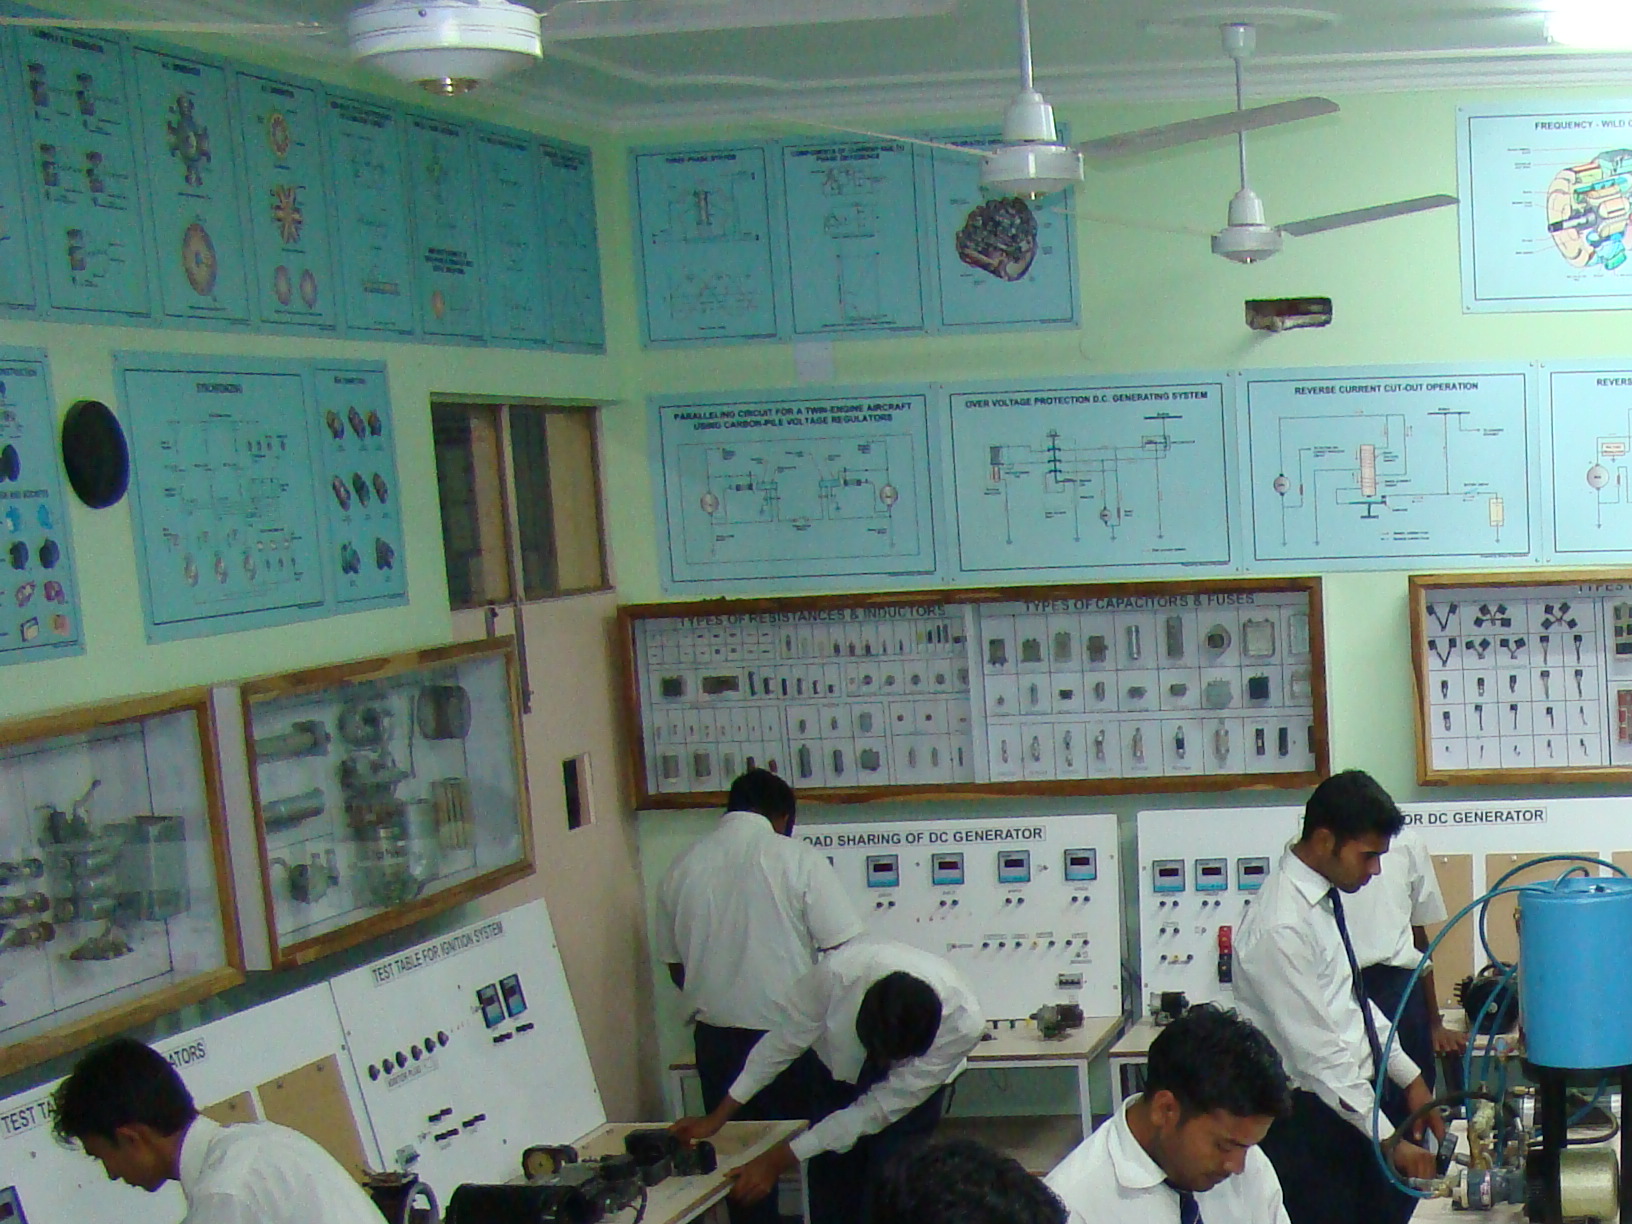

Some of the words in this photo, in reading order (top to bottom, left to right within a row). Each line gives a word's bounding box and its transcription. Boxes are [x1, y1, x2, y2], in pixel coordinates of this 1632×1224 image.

[1535, 121, 1593, 131] FREQUENCY
[1601, 119, 1625, 128] WILD
[1294, 386, 1337, 395] REVERSE
[1338, 385, 1381, 394] CURRENT
[1383, 383, 1423, 393] CUT-OUT
[1425, 382, 1479, 392] OPERATION
[965, 399, 990, 409] OVER
[991, 398, 1033, 408] VOLTAGE
[1034, 396, 1090, 406] PROTECTION
[1112, 392, 1170, 403] GENERATING
[1172, 391, 1209, 401] SYSTEM
[775, 407, 794, 417] FOR
[867, 402, 912, 412] AIRCRAFT
[786, 416, 829, 426] VOLTAGE
[1025, 600, 1069, 613] TYPES
[1074, 599, 1091, 611] OF
[1095, 596, 1191, 611] CAPACITORS
[1194, 595, 1203, 607] &
[1207, 592, 1255, 607] FUSES
[680, 612, 724, 628] TYPES
[728, 612, 748, 626] OF
[750, 608, 846, 625] RESISTANCES
[850, 608, 859, 620] &
[863, 604, 947, 620] INDUCTORS
[1403, 813, 1424, 826] OR
[1427, 812, 1449, 825] DC
[1453, 809, 1544, 824] GENERATOR
[837, 832, 901, 846] SHARING
[905, 831, 925, 845] OF
[928, 830, 950, 844] DC
[953, 827, 1043, 843] GENERATOR
[372, 963, 395, 983] TEST
[394, 952, 423, 974] TABLE
[421, 945, 441, 962] FOR
[440, 934, 475, 956] IGNITION
[473, 920, 504, 943] SYSTEM
[1, 1106, 37, 1135] TEST
